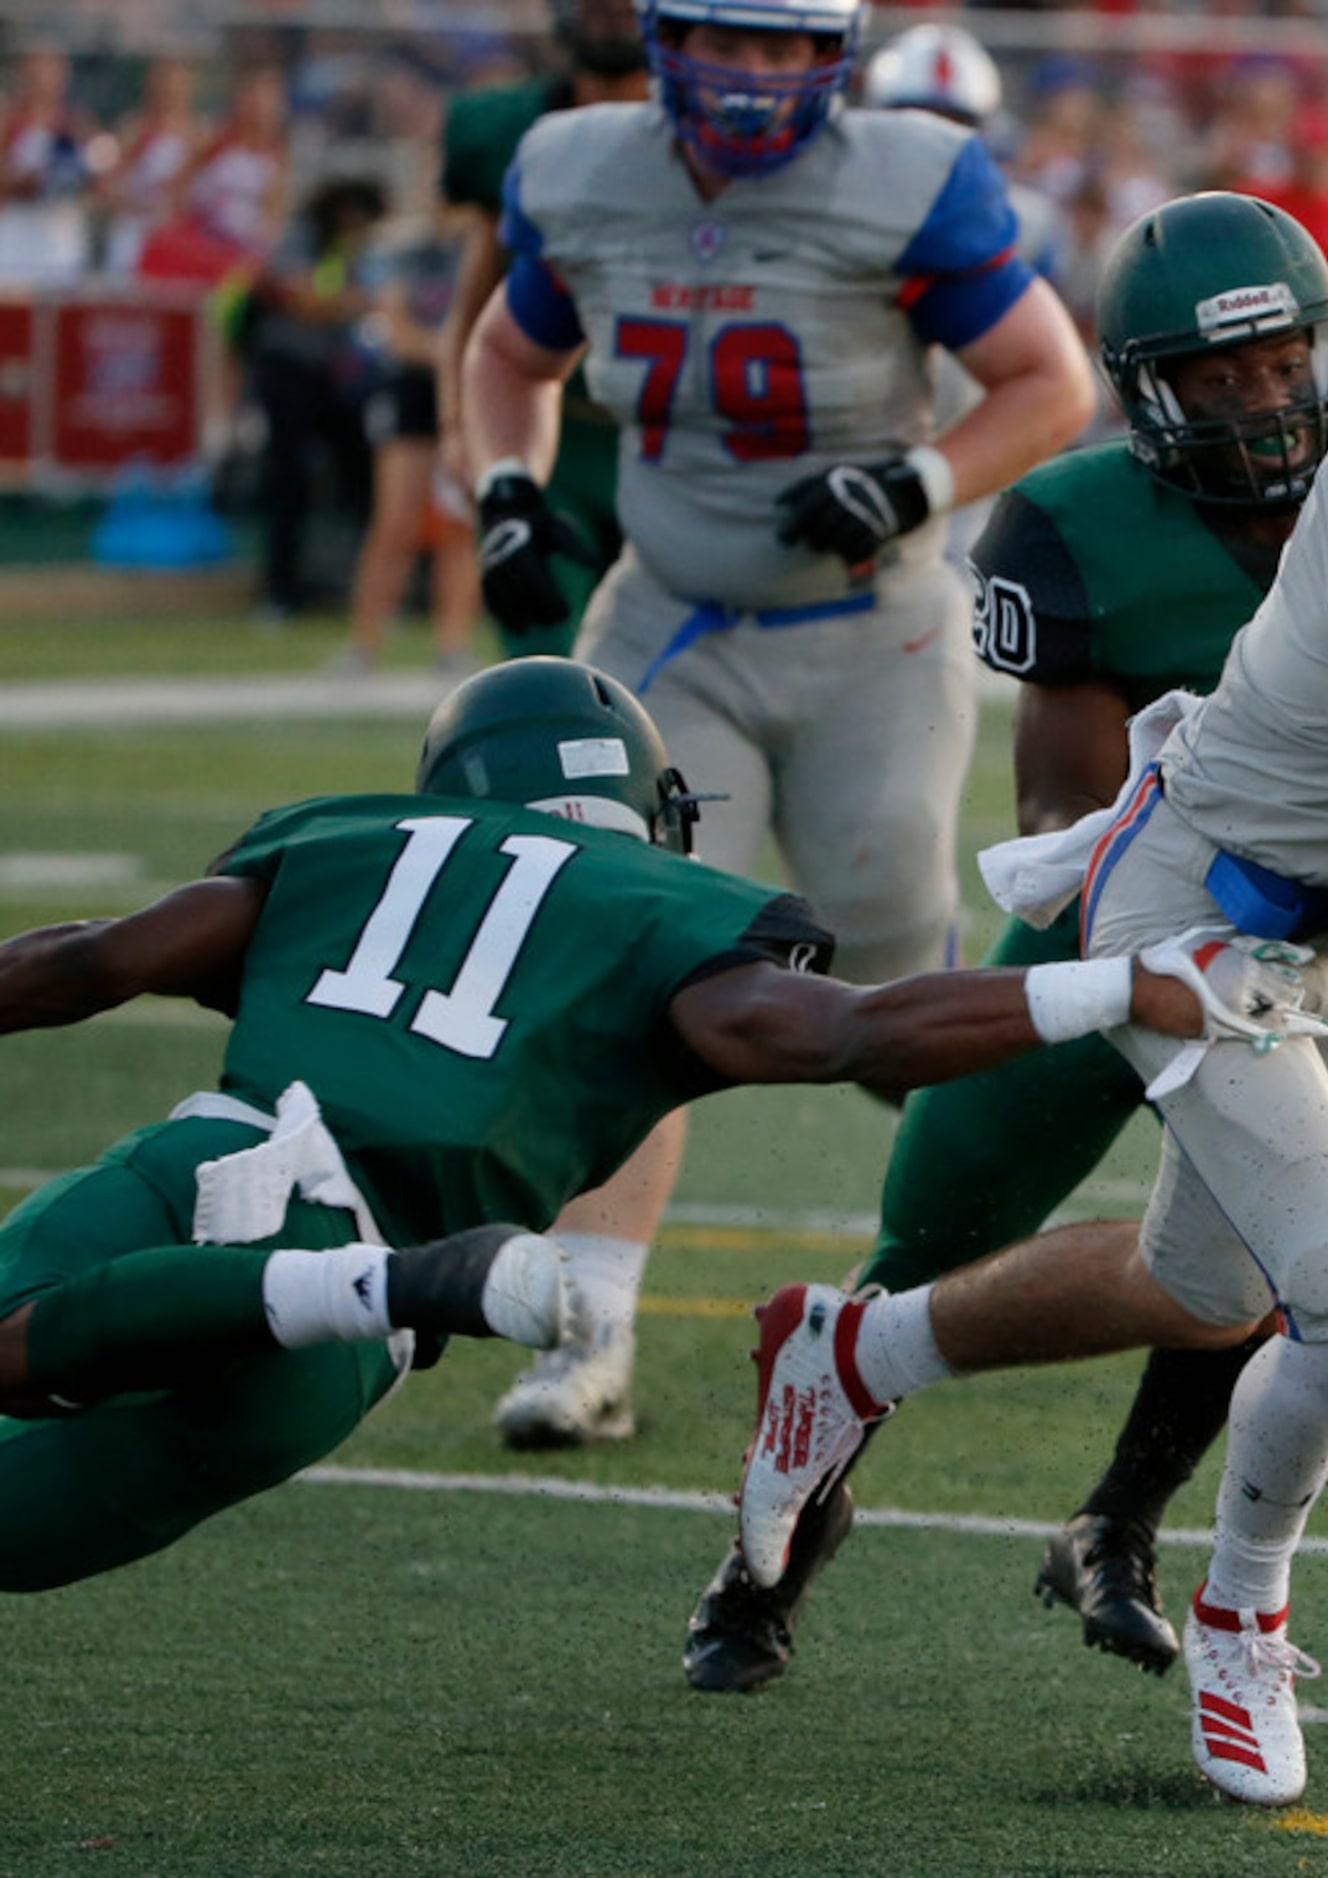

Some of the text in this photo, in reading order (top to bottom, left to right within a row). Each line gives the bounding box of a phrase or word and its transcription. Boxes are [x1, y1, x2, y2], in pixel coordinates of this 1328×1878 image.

[1217, 290, 1270, 312] Riddell
[615, 315, 812, 467] 79
[303, 815, 583, 1061] 11
